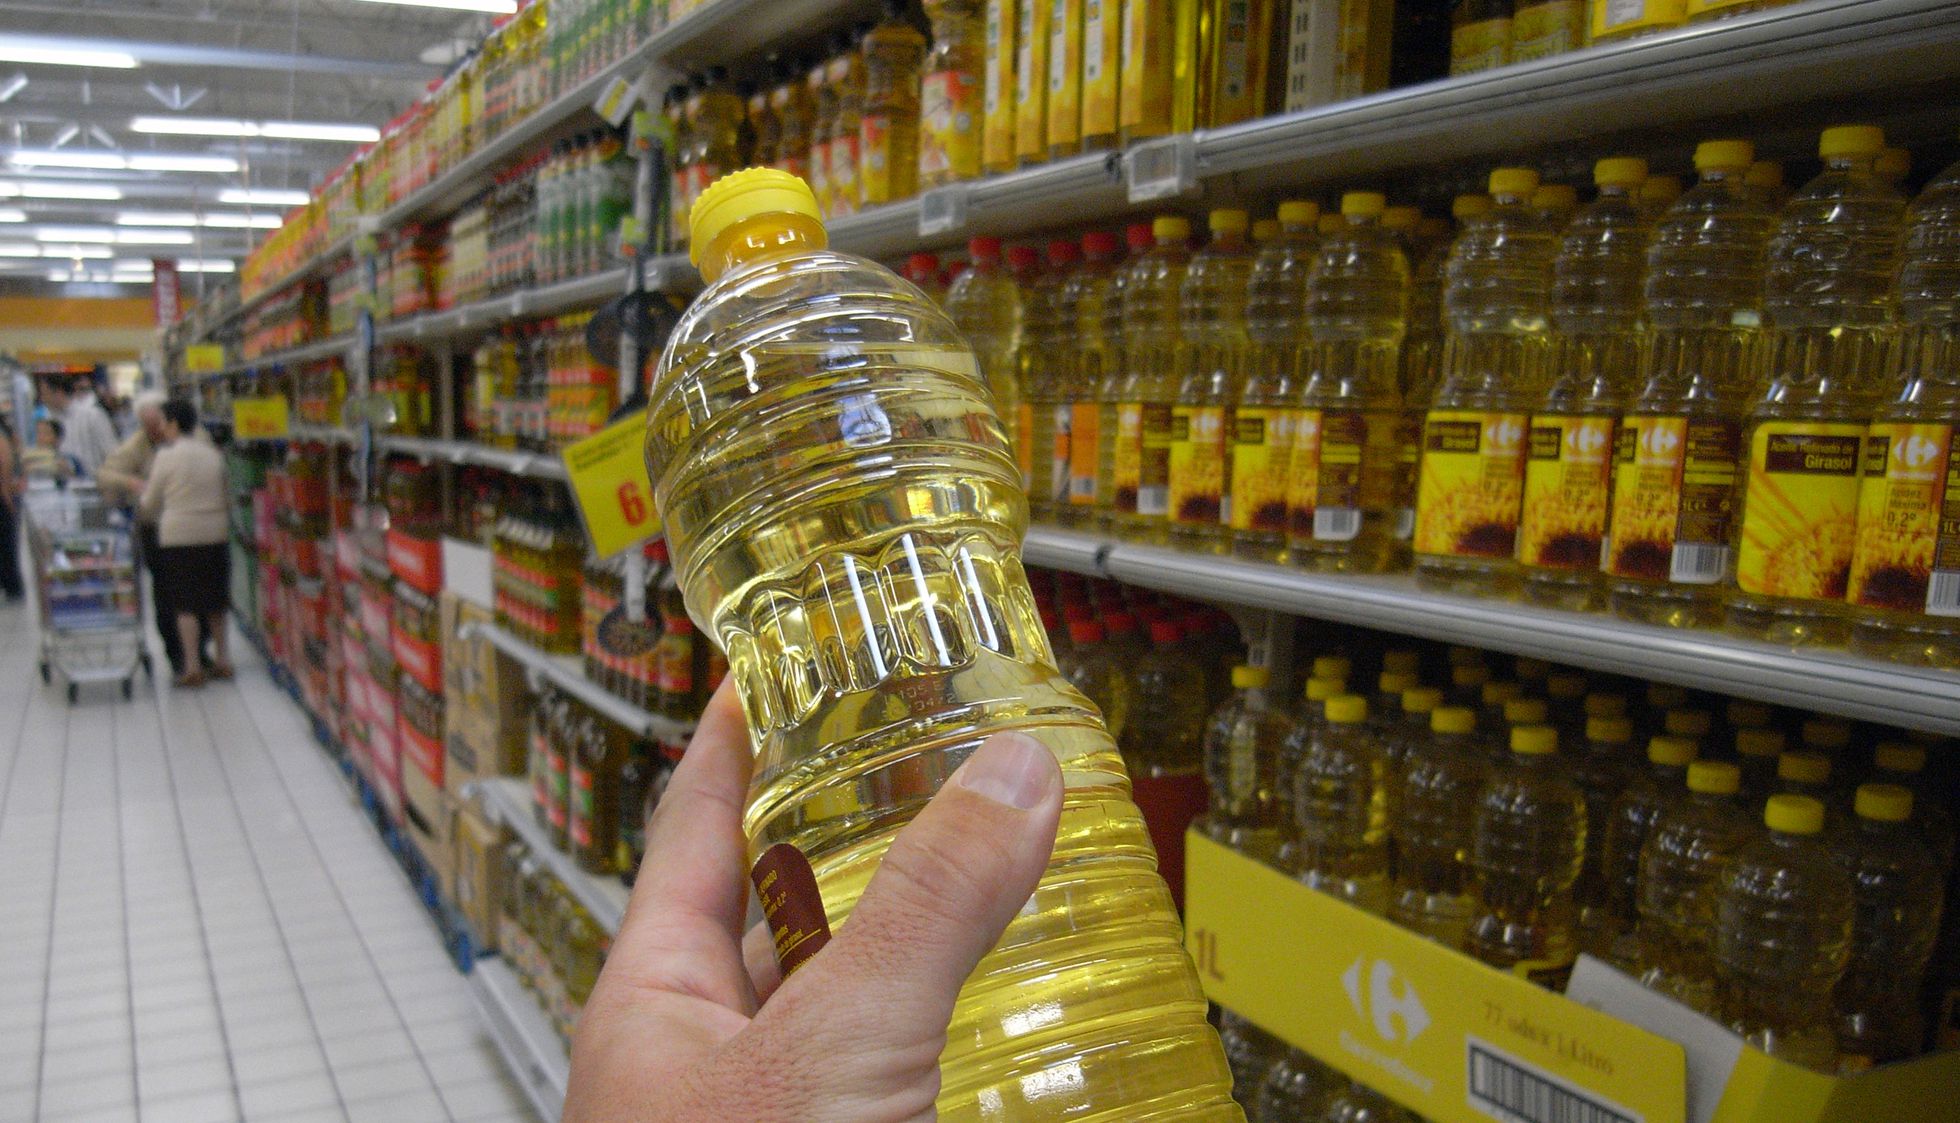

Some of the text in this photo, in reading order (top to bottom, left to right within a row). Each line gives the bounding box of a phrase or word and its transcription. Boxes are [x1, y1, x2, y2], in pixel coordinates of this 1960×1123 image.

[1804, 454, 1853, 470] Girasol
[617, 481, 653, 527] 6
[1196, 928, 1225, 982] 1L
[1571, 1038, 1615, 1076] Litro
